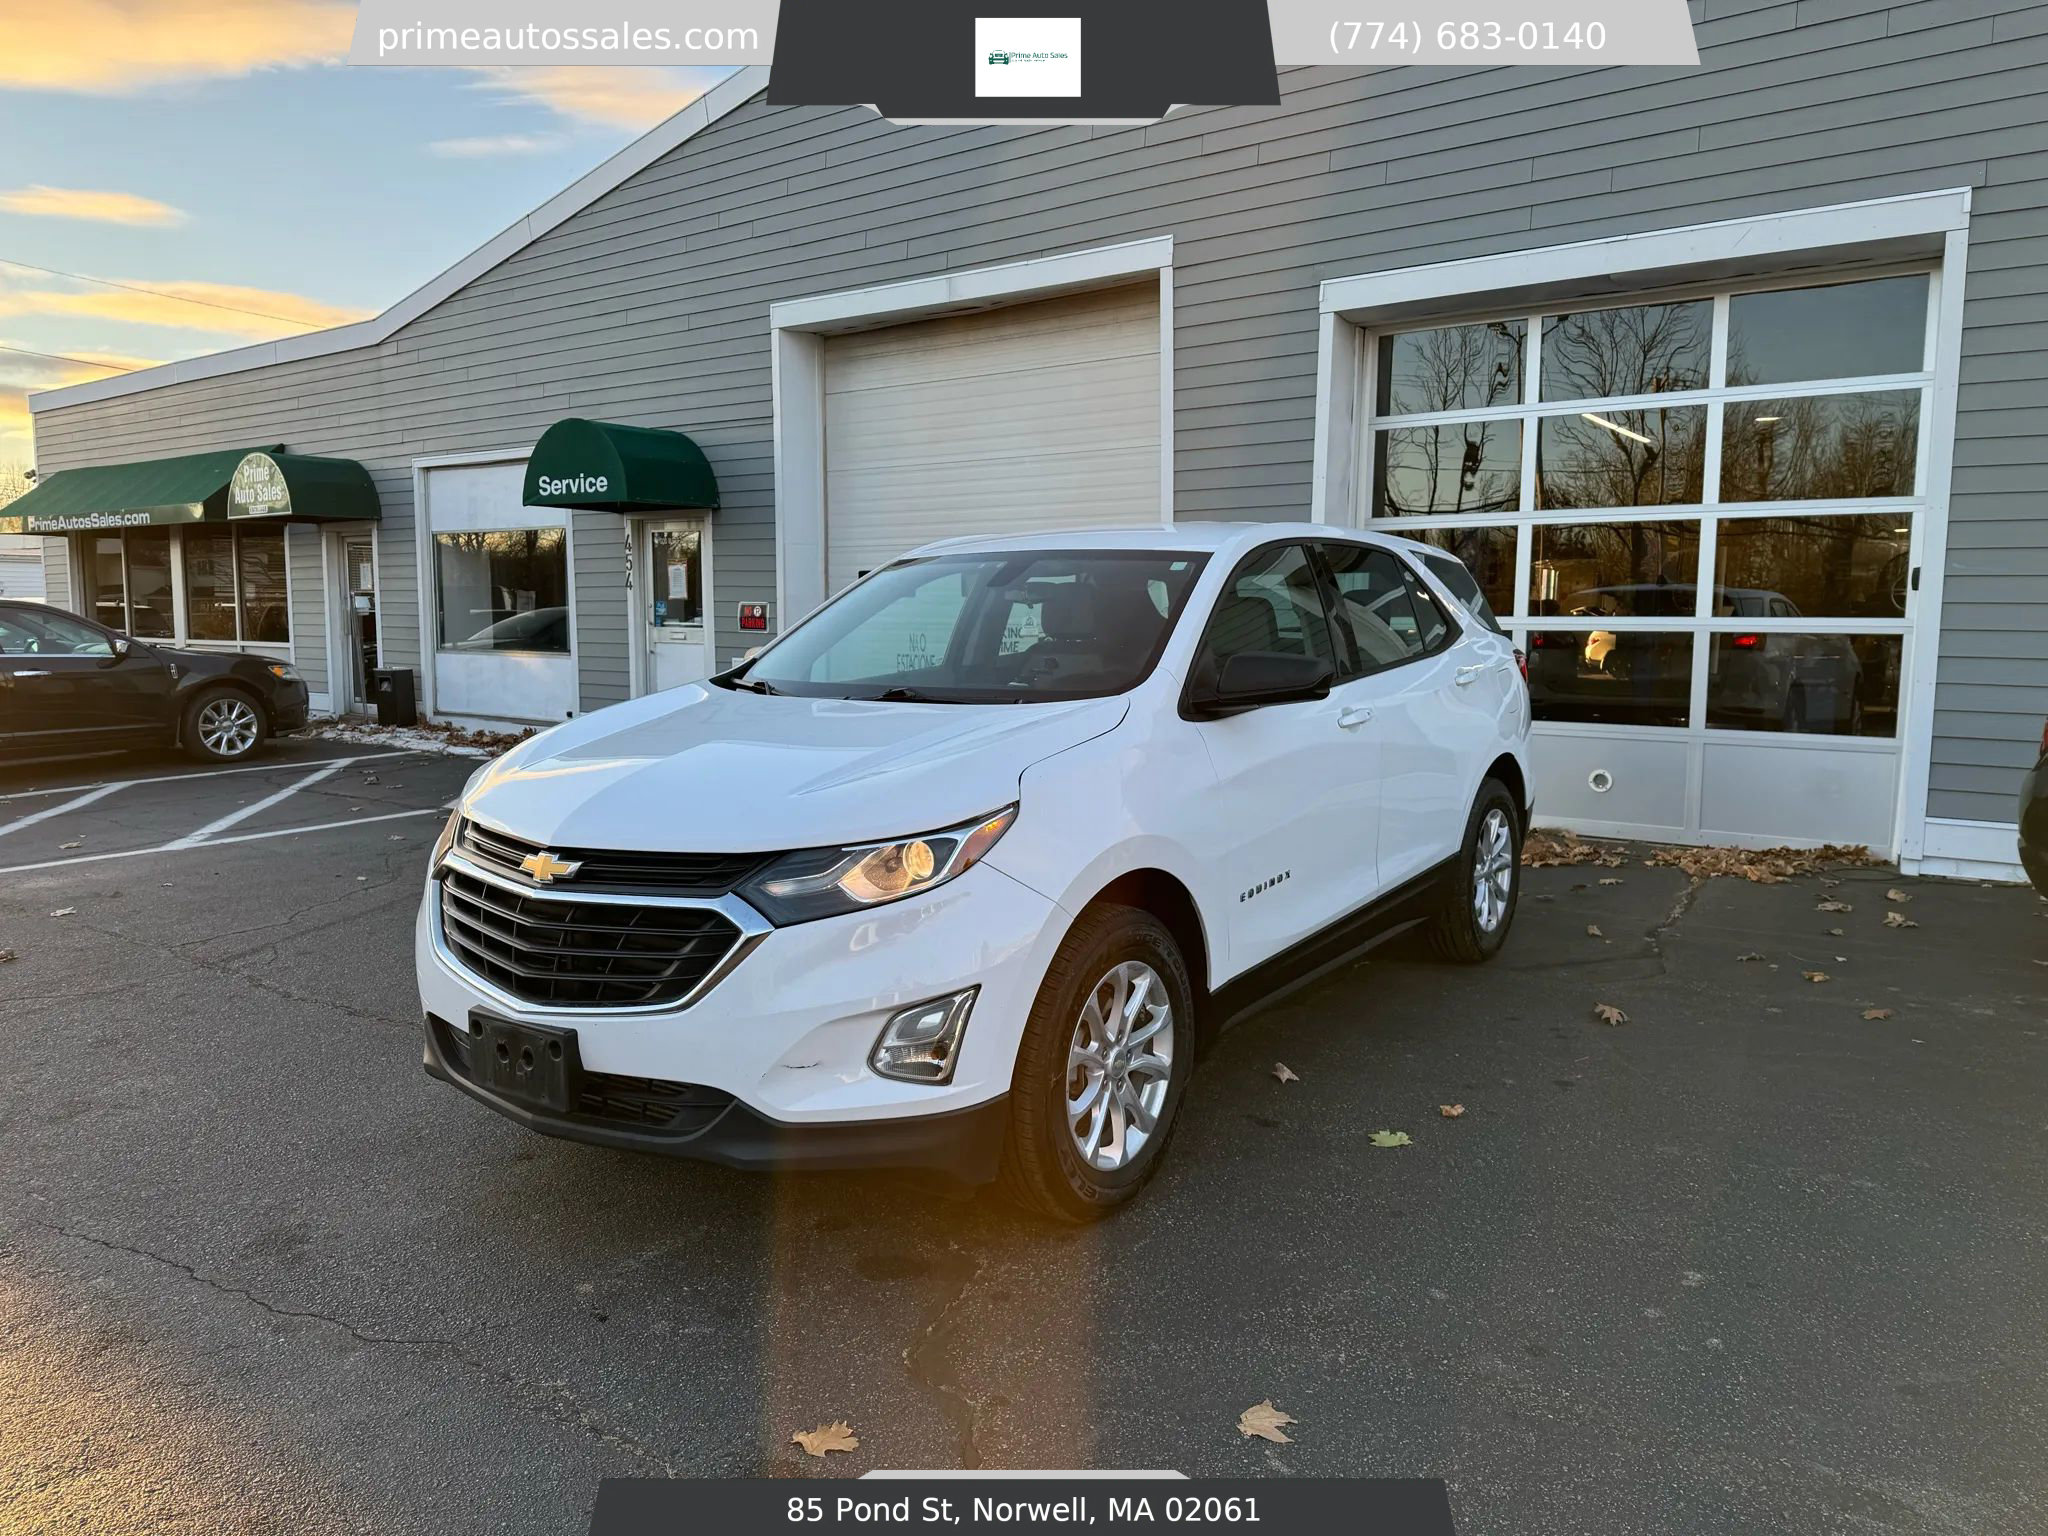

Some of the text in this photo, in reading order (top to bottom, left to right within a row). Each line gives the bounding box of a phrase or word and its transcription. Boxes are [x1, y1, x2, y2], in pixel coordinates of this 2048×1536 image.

[243, 464, 270, 483] Prime
[538, 473, 608, 496] Service
[235, 482, 282, 504] Auto Sales
[27, 511, 151, 532] PrimeAutosSales.com
[1240, 869, 1291, 903] EQUINOX
